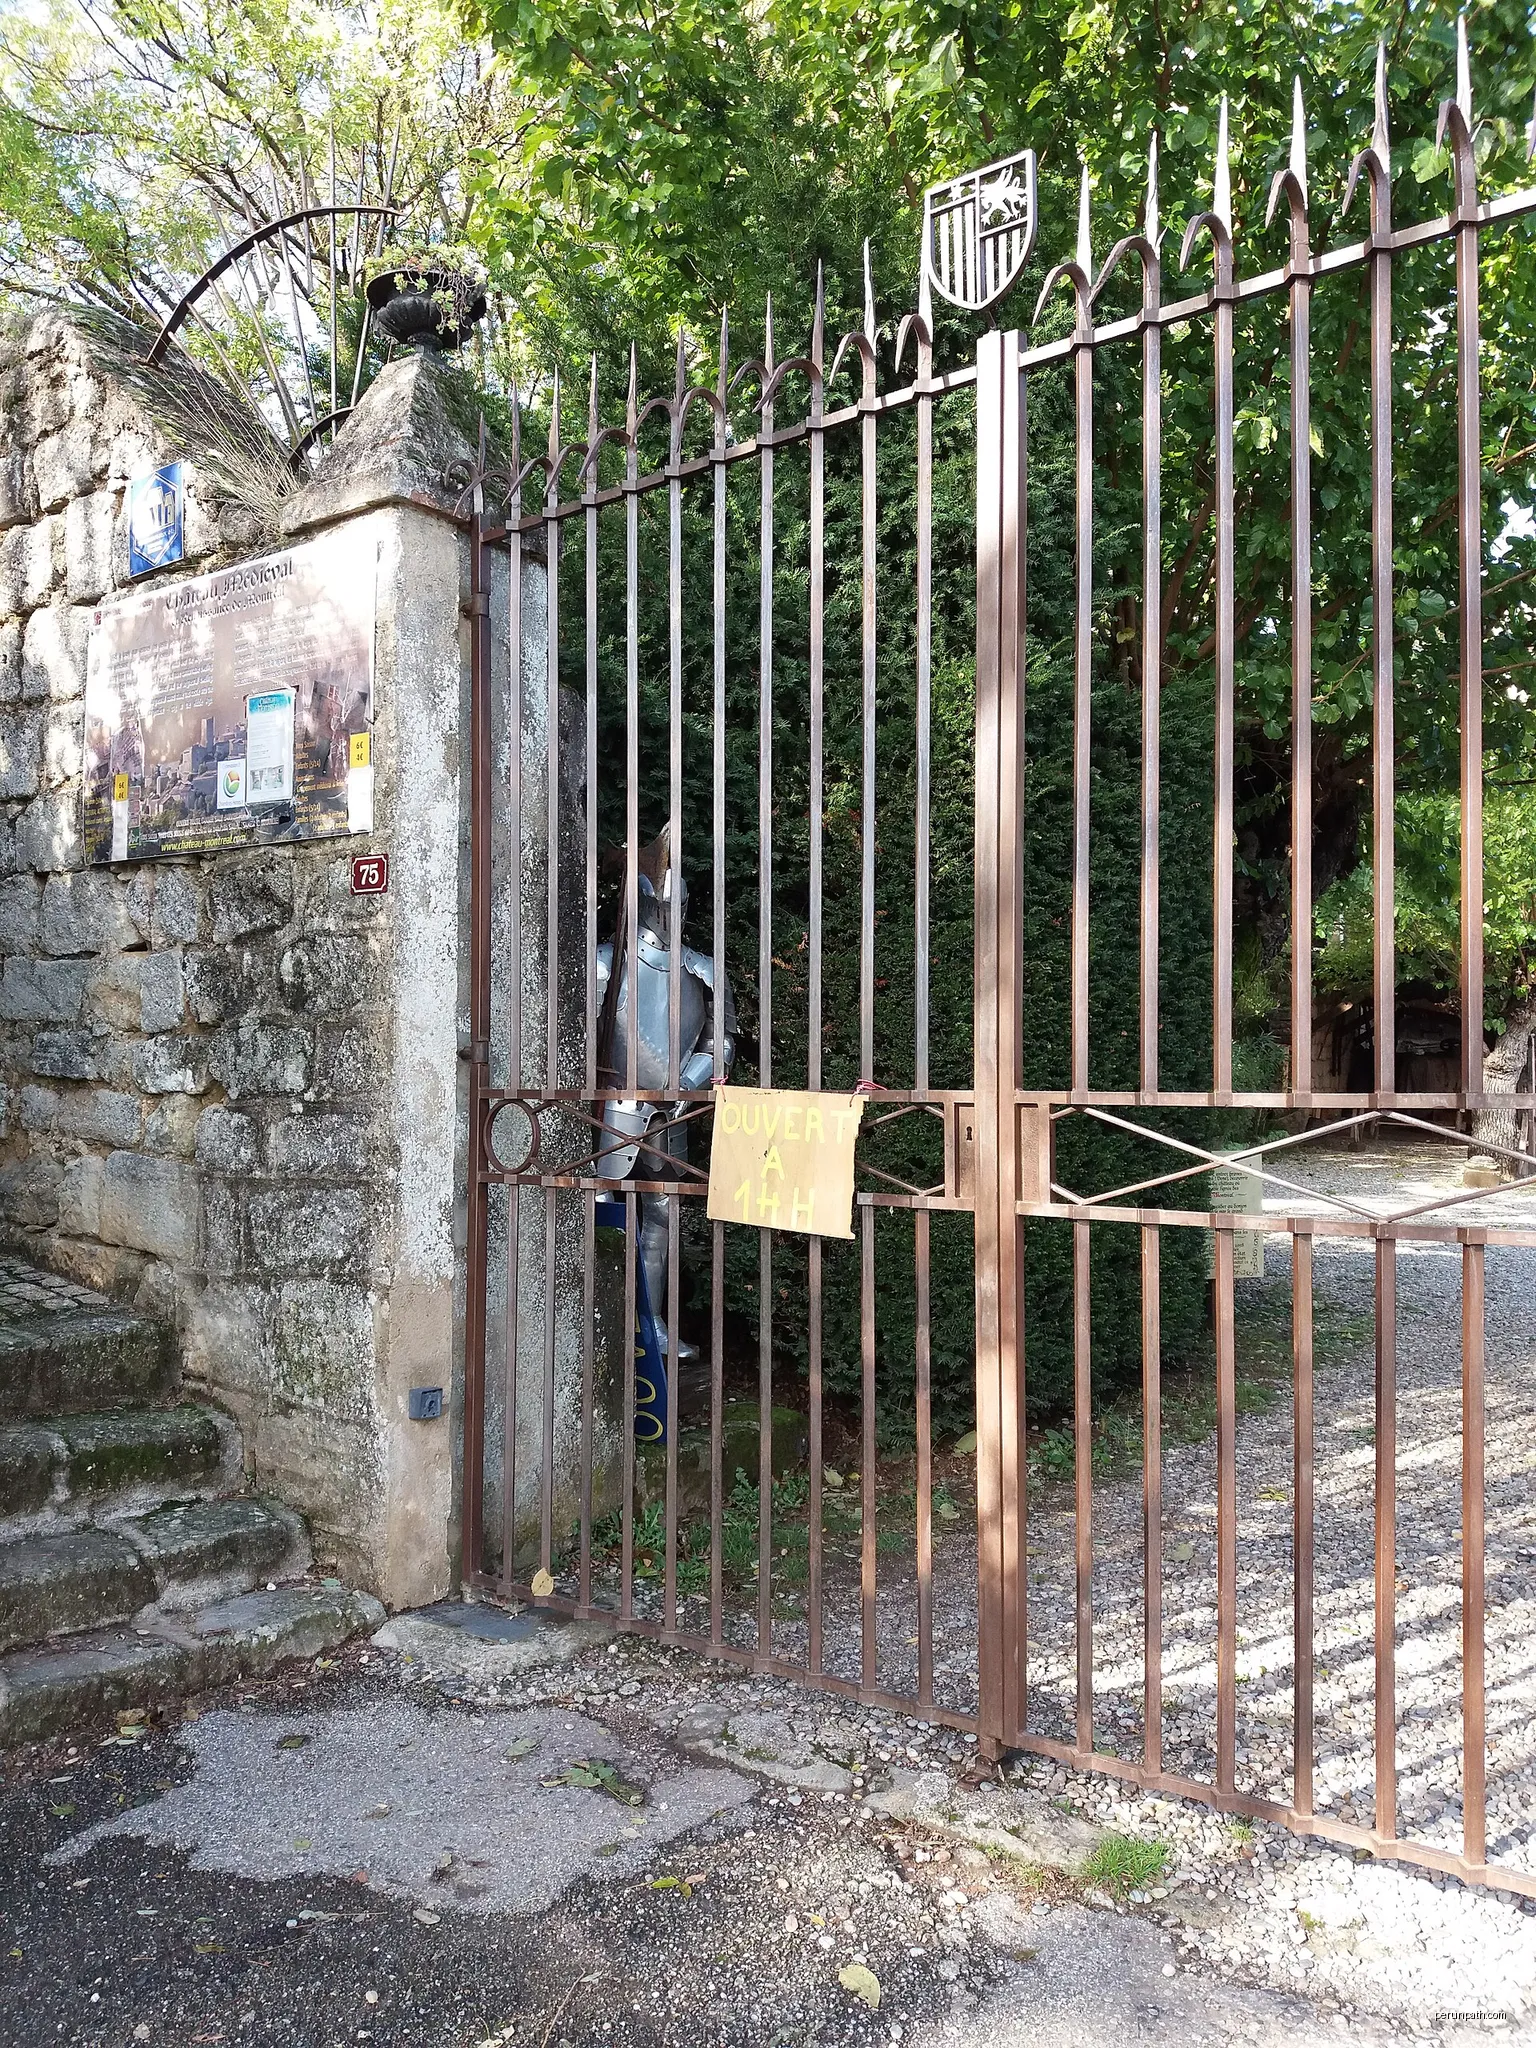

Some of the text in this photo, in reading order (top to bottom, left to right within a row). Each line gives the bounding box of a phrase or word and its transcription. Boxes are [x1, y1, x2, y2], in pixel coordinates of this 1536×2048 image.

[161, 834, 248, 852] www.chateau-montreal.com
[359, 862, 379, 885] 75
[721, 1102, 856, 1145] OUVERT
[760, 1145, 785, 1181] A
